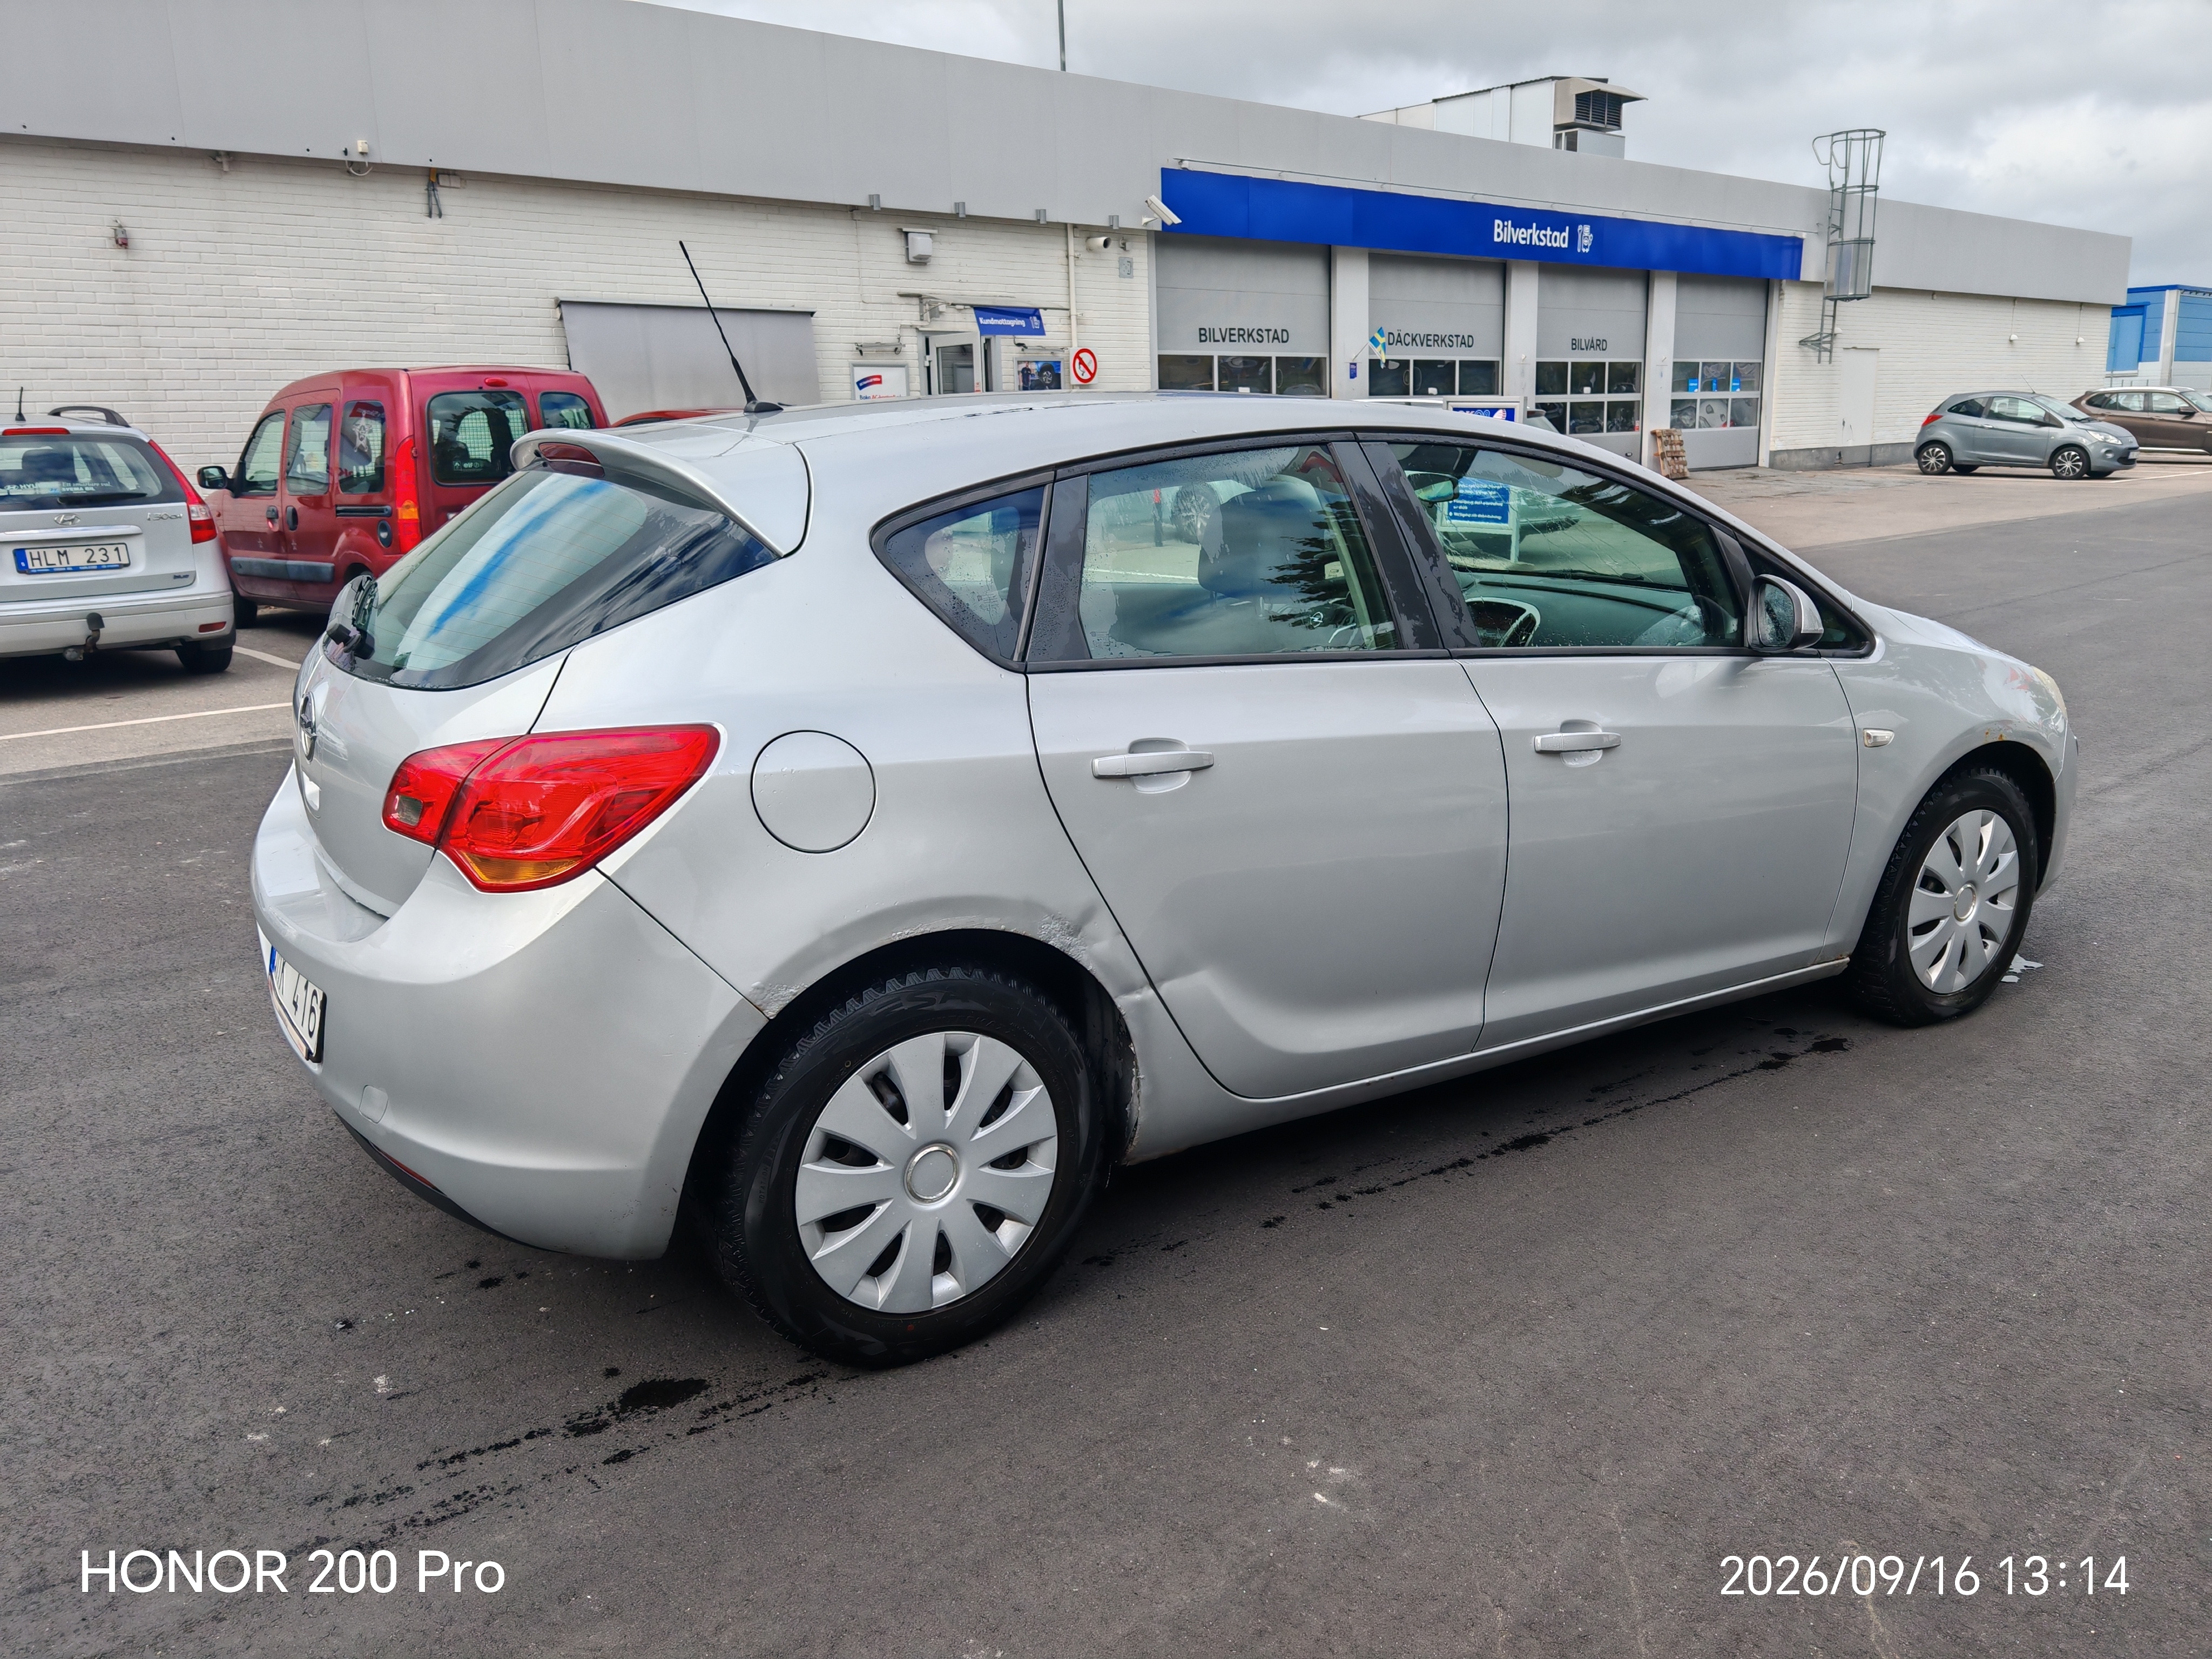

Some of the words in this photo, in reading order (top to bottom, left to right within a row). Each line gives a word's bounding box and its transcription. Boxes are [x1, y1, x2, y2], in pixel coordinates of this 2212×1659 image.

[1494, 219, 1569, 248] Bilverkstad
[979, 317, 1026, 327] Kundmottagning
[1198, 327, 1290, 343] BILVERKSTAD
[1387, 329, 1474, 348] DÄCKVERKSTAD
[1571, 336, 1608, 352] BILVÅRD
[29, 549, 70, 567] HLM
[84, 547, 122, 564] 231
[293, 973, 318, 1038] 416
